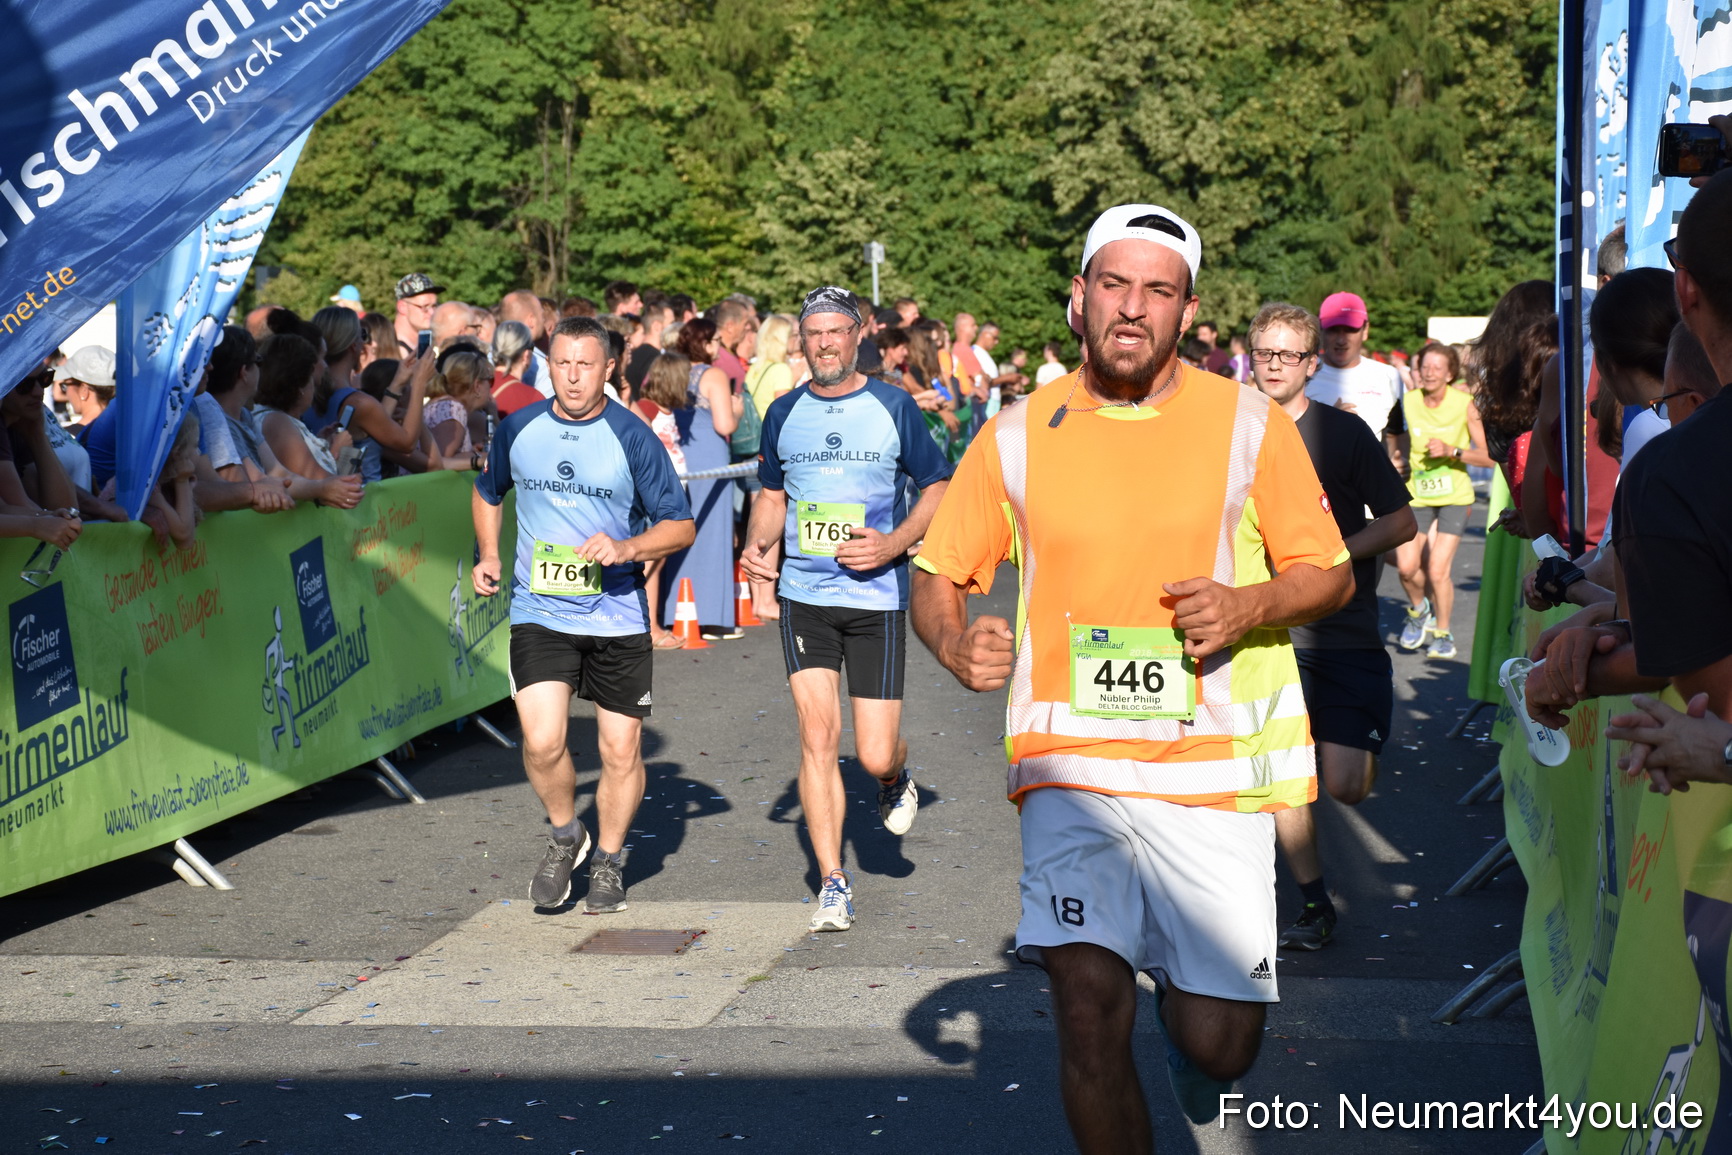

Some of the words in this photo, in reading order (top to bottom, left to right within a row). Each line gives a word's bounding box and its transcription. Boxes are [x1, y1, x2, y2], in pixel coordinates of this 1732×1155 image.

[186, 38, 282, 124] Druck
[0, 0, 278, 247] ischma
[789, 450, 881, 464] SCHABMÜLLER
[819, 466, 844, 475] TEAM
[522, 478, 613, 500] SCHABMÜLLER
[1420, 478, 1443, 491] 931
[551, 498, 577, 508] TEAM
[805, 521, 853, 542] 1769
[104, 546, 158, 613] Gesunde
[540, 561, 589, 582] 1761
[21, 628, 60, 661] Fischer
[1084, 640, 1125, 650] firmenlauf
[27, 649, 60, 672] AUTOMOBILE
[294, 605, 370, 713] firmenlauf
[1094, 660, 1165, 693] 446
[1100, 694, 1131, 703] Nübler
[1133, 695, 1161, 704] Philip
[0, 667, 129, 804] irmenlauf
